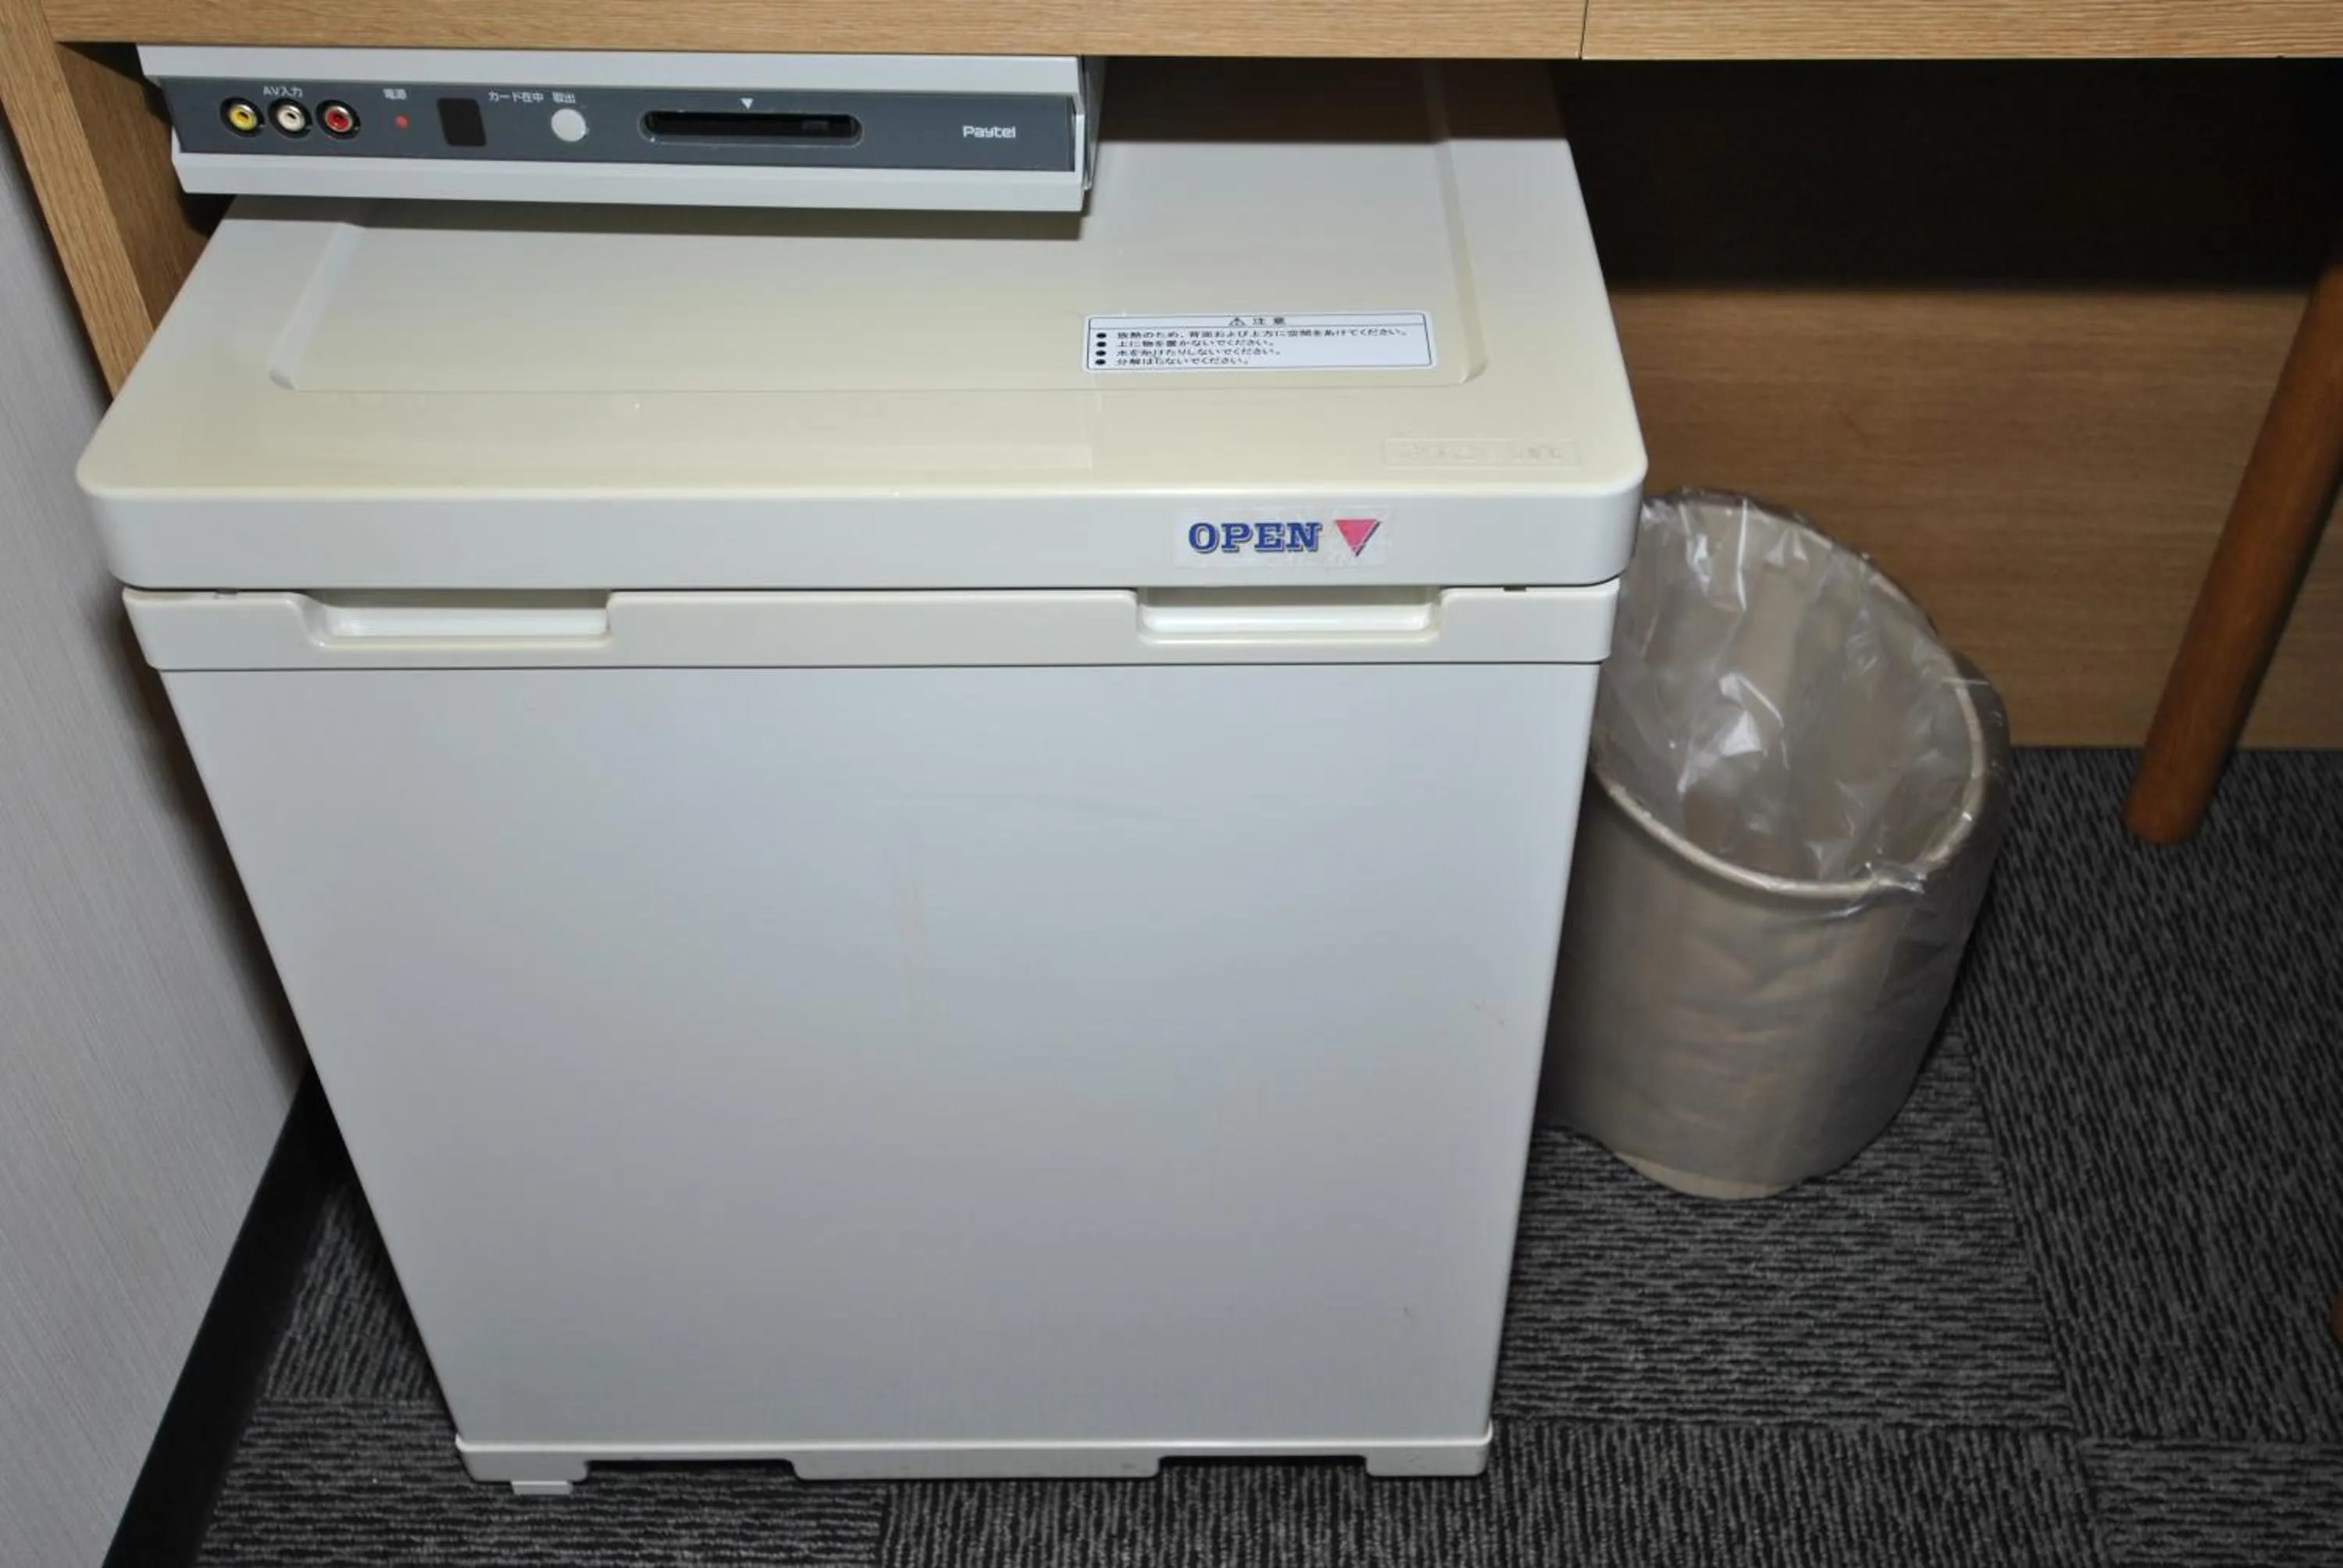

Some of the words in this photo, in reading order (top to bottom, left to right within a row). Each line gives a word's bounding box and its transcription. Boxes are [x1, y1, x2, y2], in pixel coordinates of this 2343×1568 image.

[262, 85, 303, 98] AV入力
[962, 125, 1017, 139] Paytel
[1187, 522, 1322, 554] OPEN
